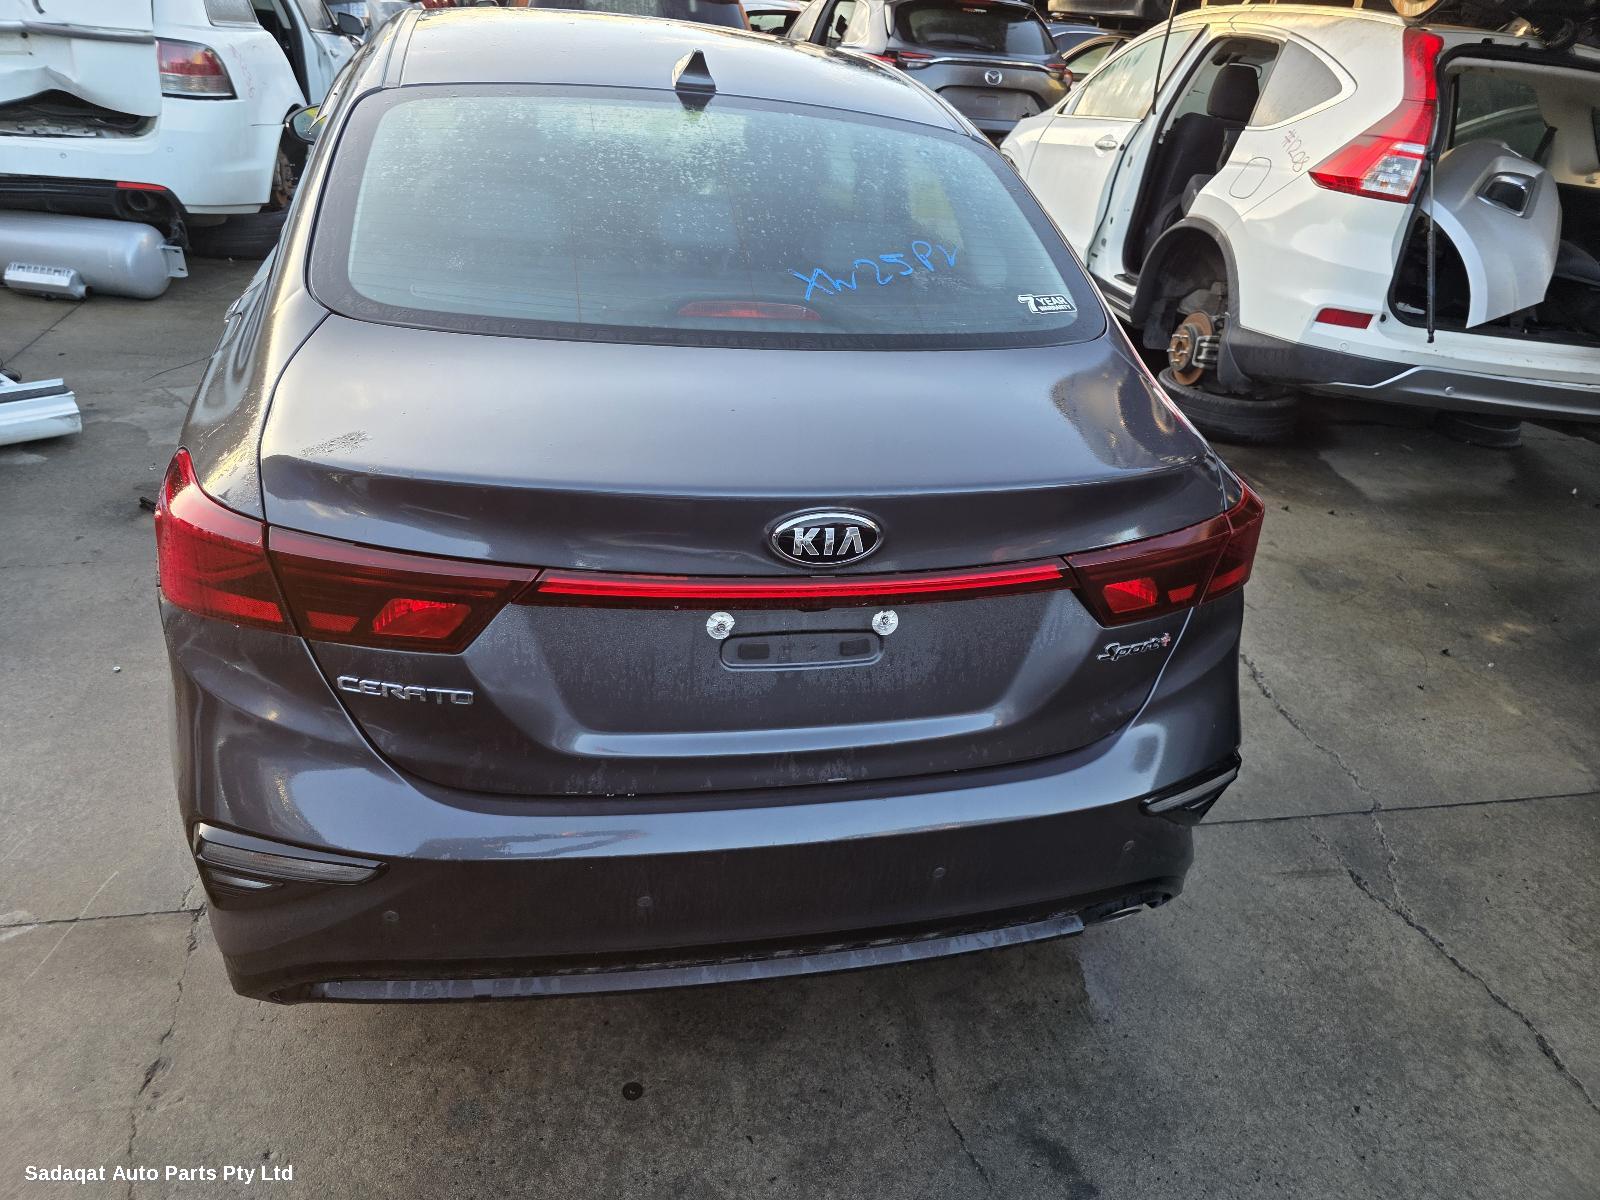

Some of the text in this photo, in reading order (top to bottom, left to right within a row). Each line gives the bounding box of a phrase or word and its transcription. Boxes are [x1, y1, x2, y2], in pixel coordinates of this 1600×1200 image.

[1017, 295, 1069, 312] 7 YEAR
[792, 526, 864, 556] KIA
[336, 675, 475, 706] CERATO
